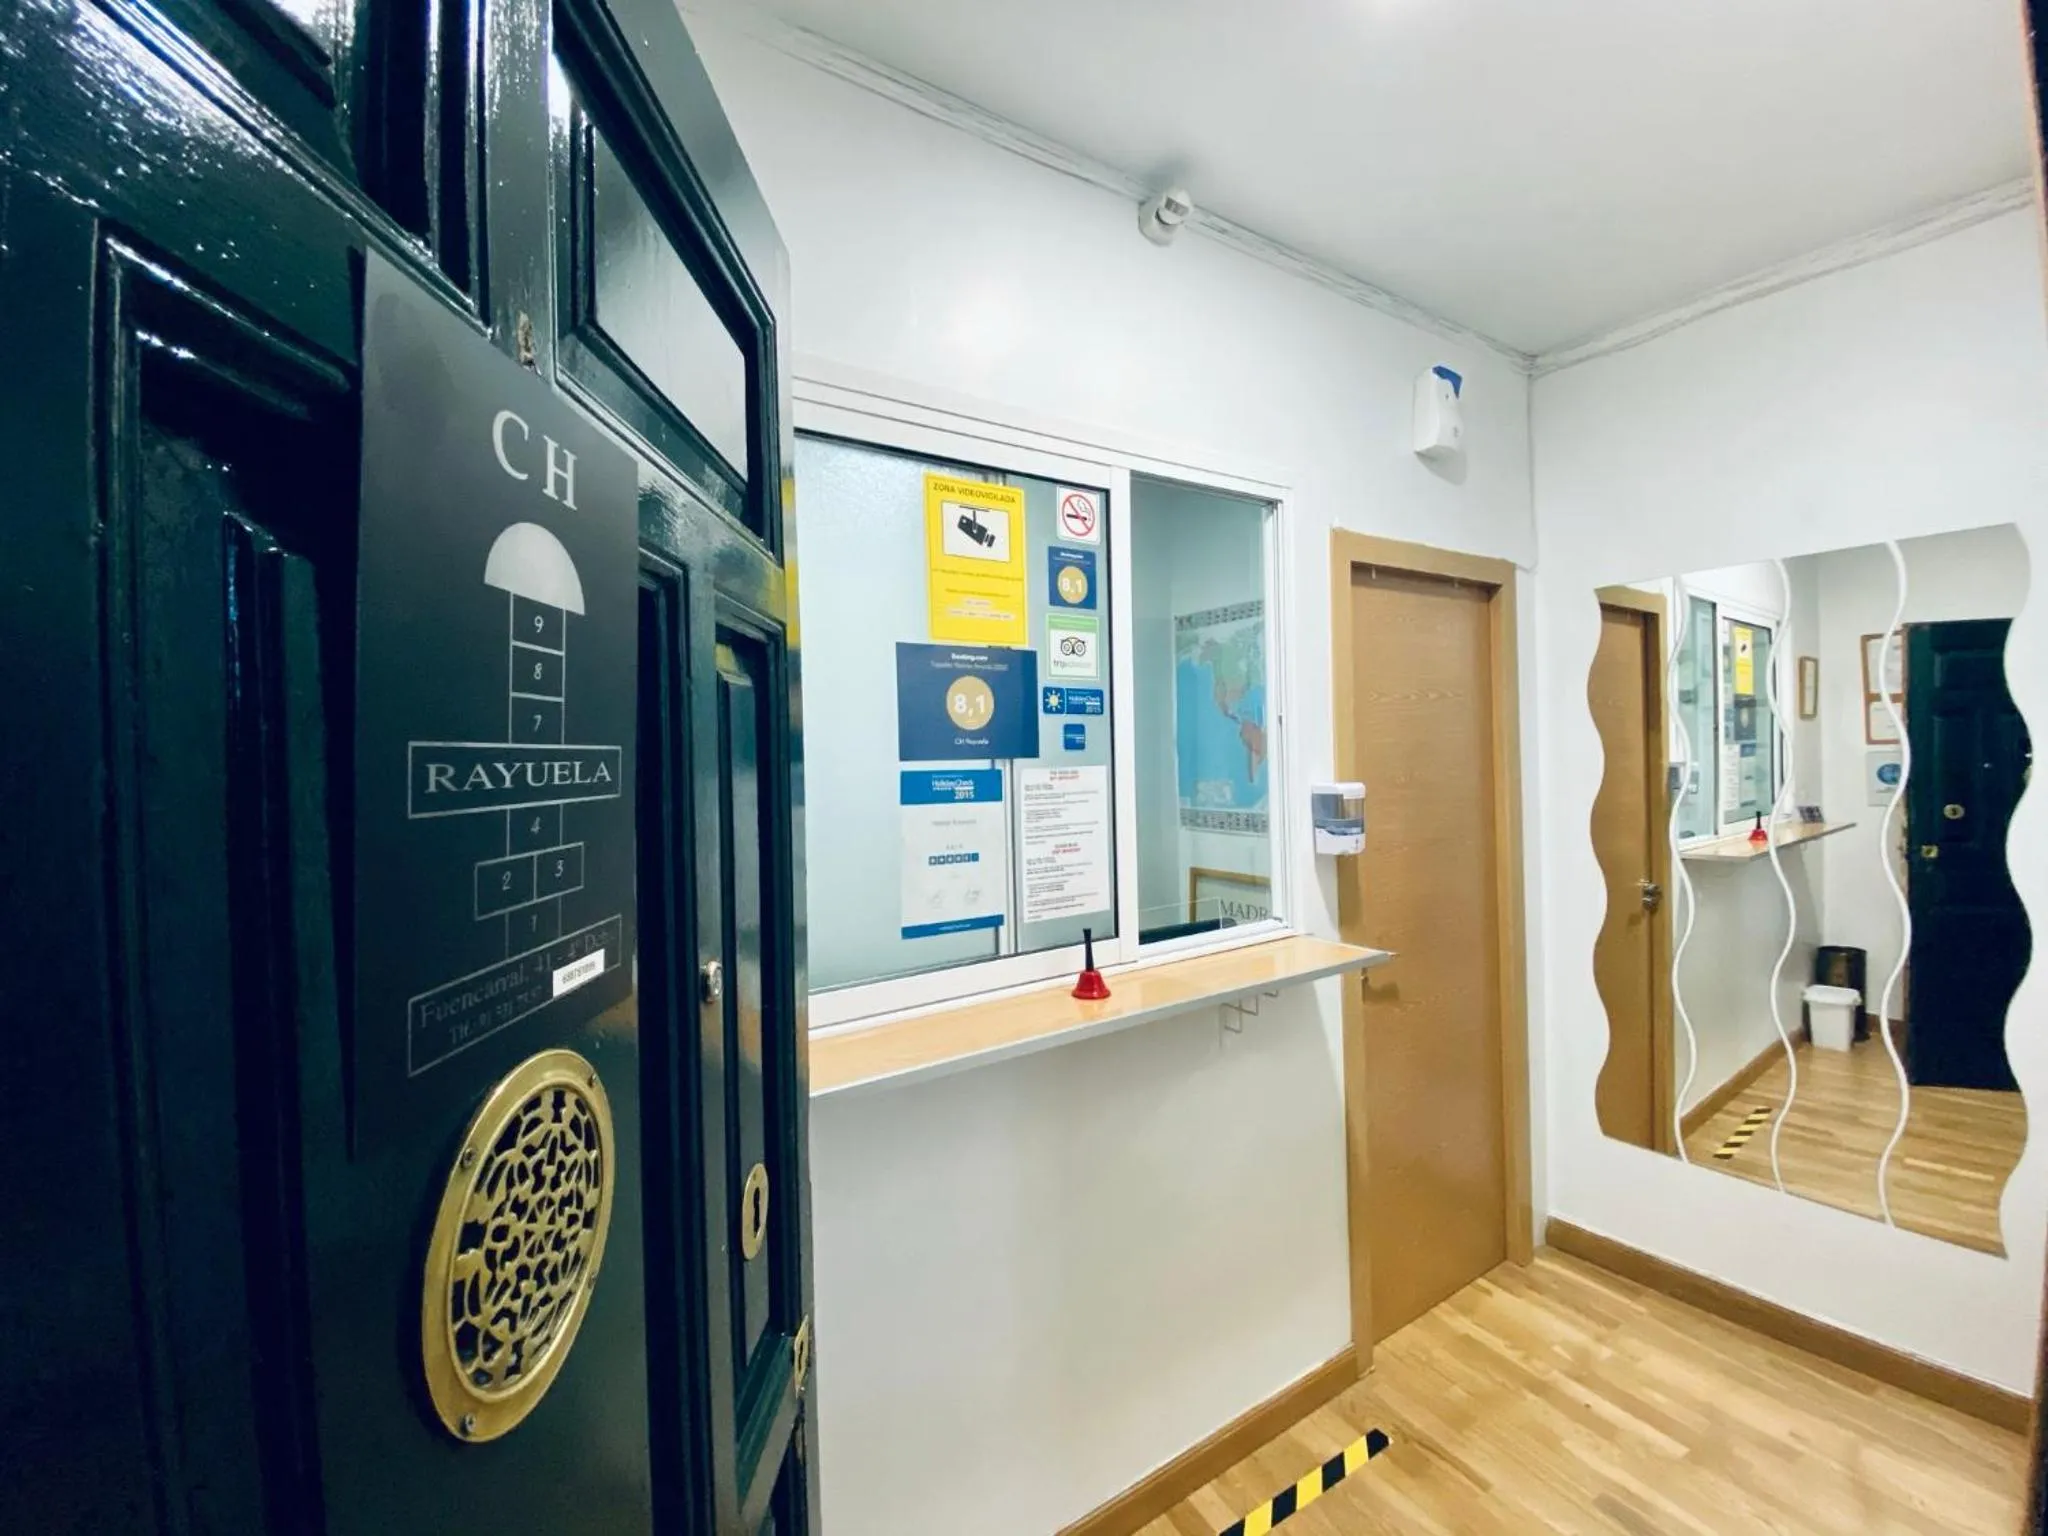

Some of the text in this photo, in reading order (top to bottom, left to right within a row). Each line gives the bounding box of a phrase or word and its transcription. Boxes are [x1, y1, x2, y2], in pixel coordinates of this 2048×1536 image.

[933, 482, 1016, 503] ZONA VIDEOVIGILADA
[534, 615, 544, 633] 9
[533, 662, 543, 680] 8
[532, 714, 543, 732] 7
[425, 761, 612, 794] RAYUELA
[530, 816, 541, 835] 4
[554, 859, 564, 878] 3
[502, 871, 512, 891] 2
[529, 914, 538, 933] 1
